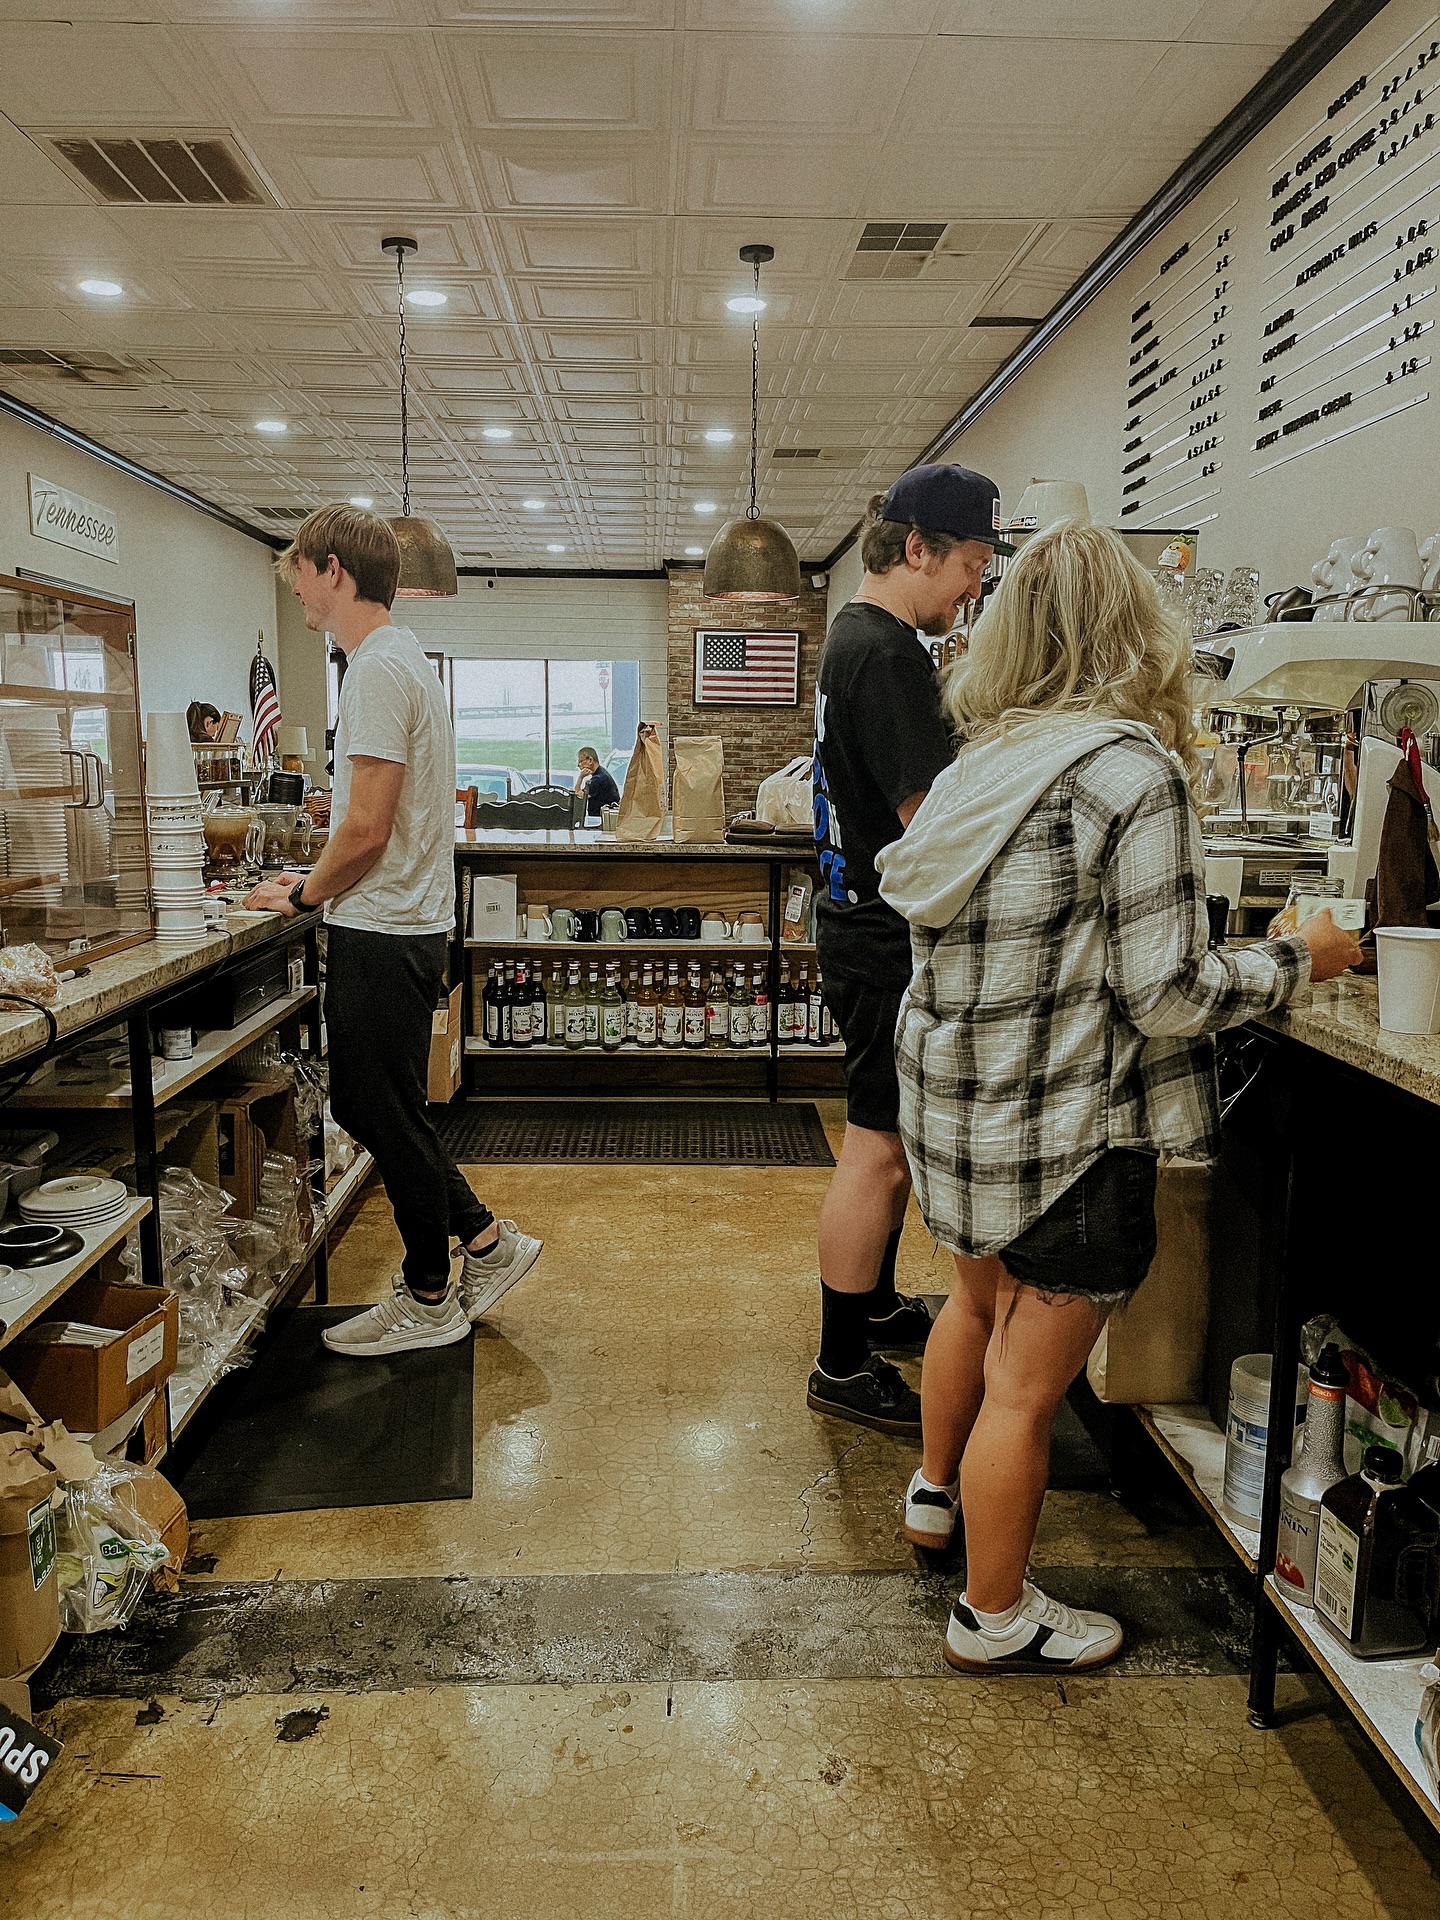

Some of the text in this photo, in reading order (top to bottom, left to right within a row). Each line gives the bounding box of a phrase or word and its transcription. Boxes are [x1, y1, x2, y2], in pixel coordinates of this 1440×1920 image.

[1296, 135, 1333, 176] COFFEE
[1314, 161, 1337, 189] ICED
[1337, 127, 1377, 170] COFFEE
[1270, 224, 1295, 252] COLD
[1301, 195, 1330, 228] BREW
[1296, 221, 1378, 288] ALTERNATE MILKS
[34, 490, 116, 547] Tennessee
